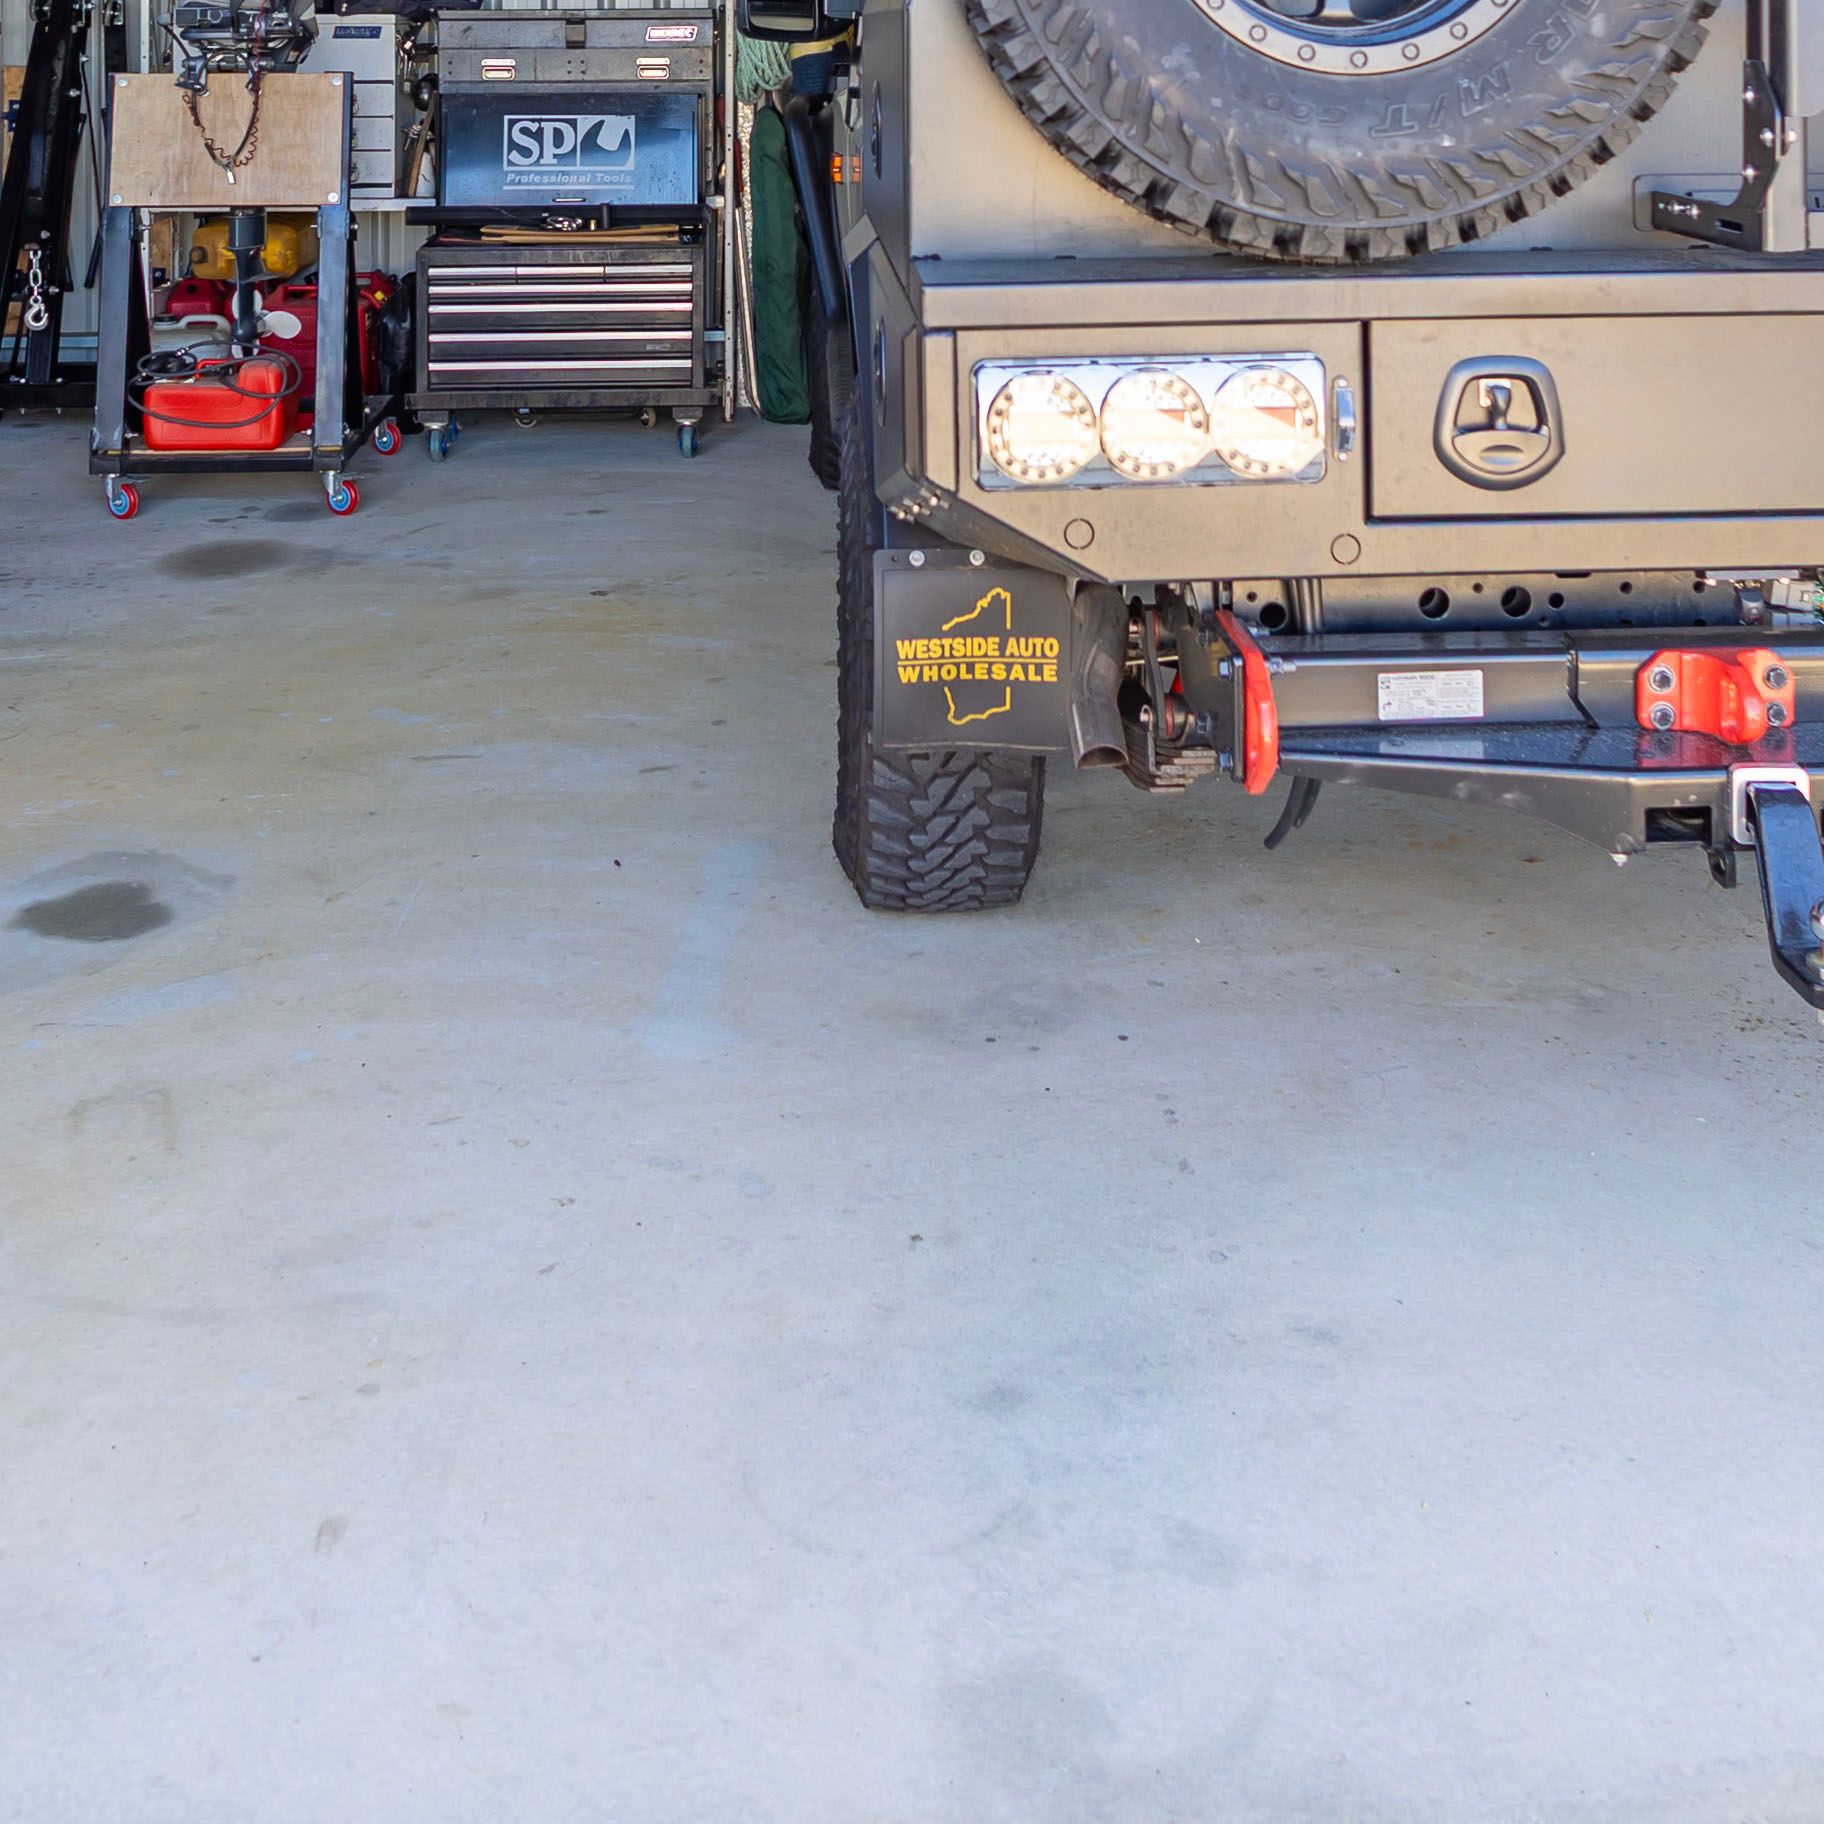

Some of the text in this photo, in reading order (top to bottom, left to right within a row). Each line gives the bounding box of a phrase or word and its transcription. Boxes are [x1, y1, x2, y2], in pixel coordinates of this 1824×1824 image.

[508, 120, 576, 166] SP
[506, 172, 633, 184] Professional Tools
[896, 636, 1060, 660] WESTSIDE AUTO
[897, 662, 1058, 684] WHOLESALE
